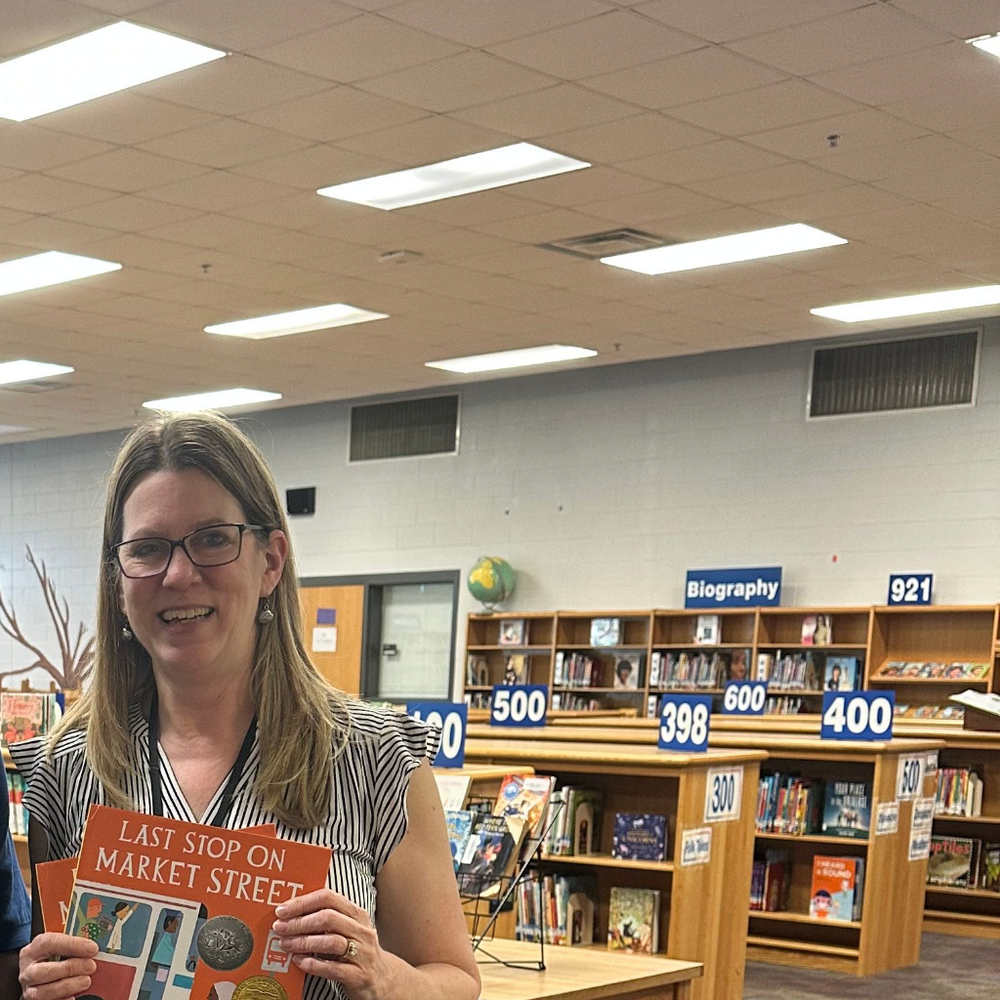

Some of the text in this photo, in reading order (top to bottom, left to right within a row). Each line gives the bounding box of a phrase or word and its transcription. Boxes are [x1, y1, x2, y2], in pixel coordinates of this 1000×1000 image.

[687, 579, 779, 602] Biography
[890, 577, 930, 602] 921
[492, 690, 546, 722] 500
[724, 684, 766, 712] 600
[823, 697, 892, 734] 400
[414, 711, 463, 759] 00
[660, 702, 708, 745] 398
[712, 774, 735, 813] 300
[118, 820, 286, 872] LAST STOP ON
[930, 840, 969, 855] ptiles
[95, 846, 304, 906] MARKET STREET
